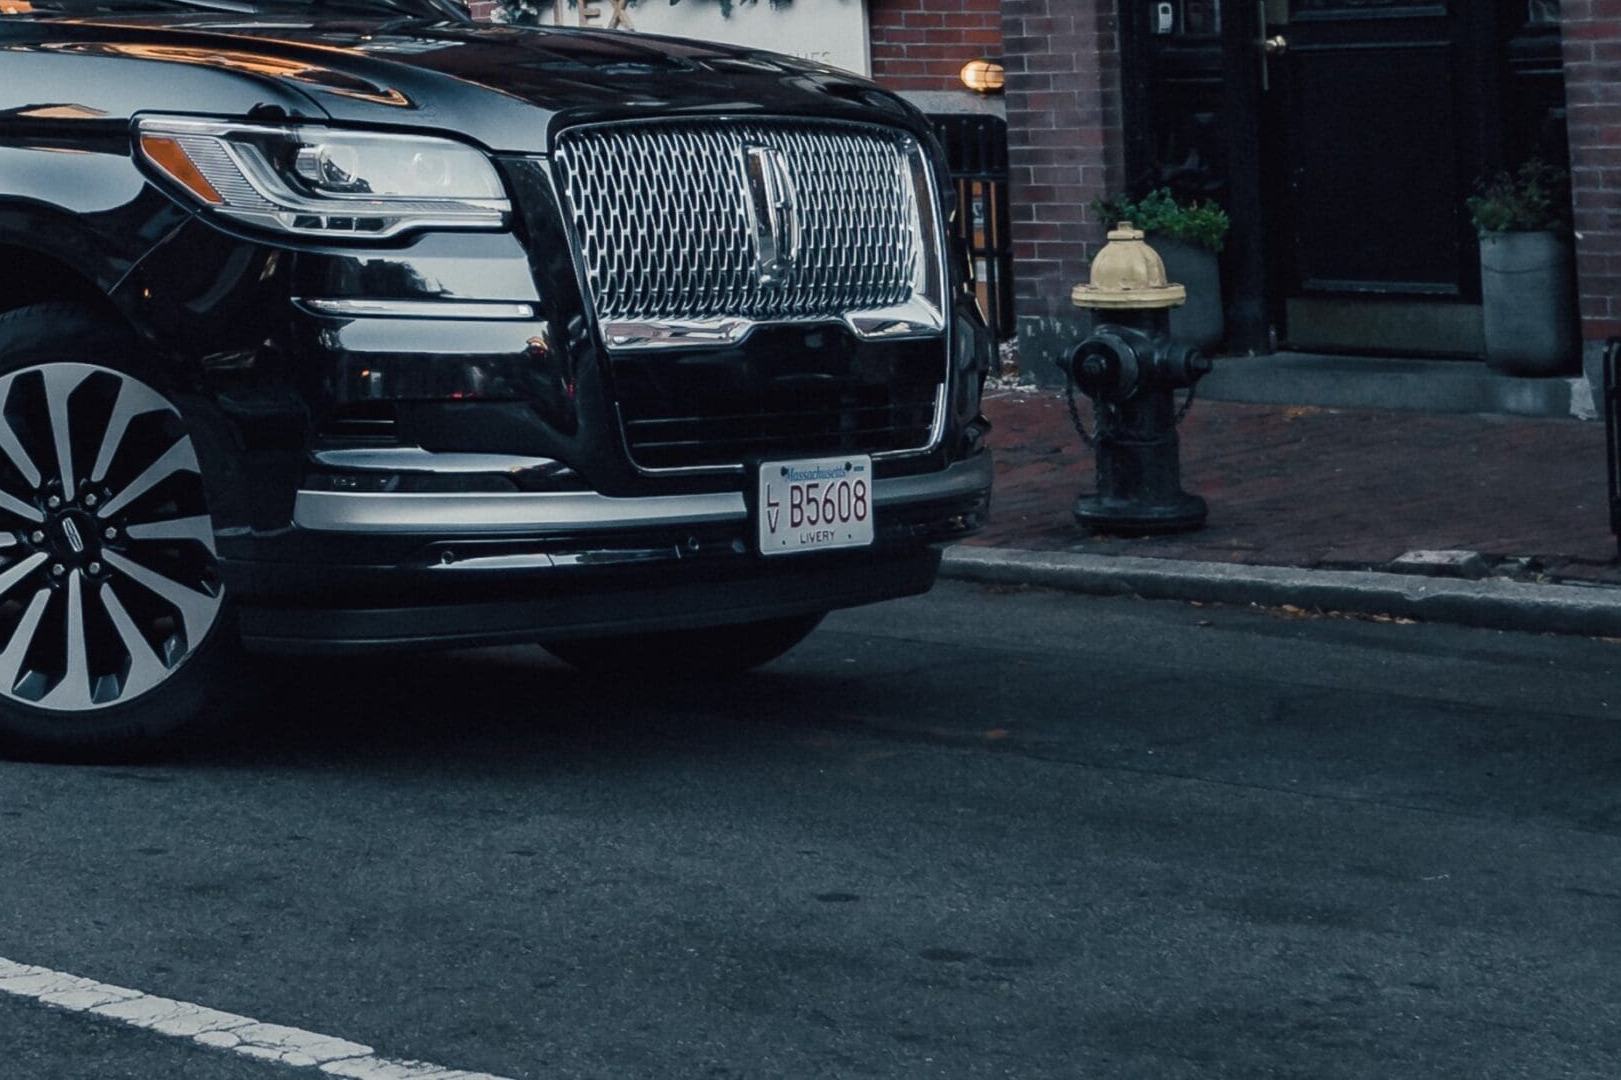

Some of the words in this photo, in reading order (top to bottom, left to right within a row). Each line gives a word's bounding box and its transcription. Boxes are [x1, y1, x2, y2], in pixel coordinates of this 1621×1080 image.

[784, 465, 847, 481] Massachusetts
[790, 479, 867, 528] B5608
[800, 530, 836, 544] LIVERY
